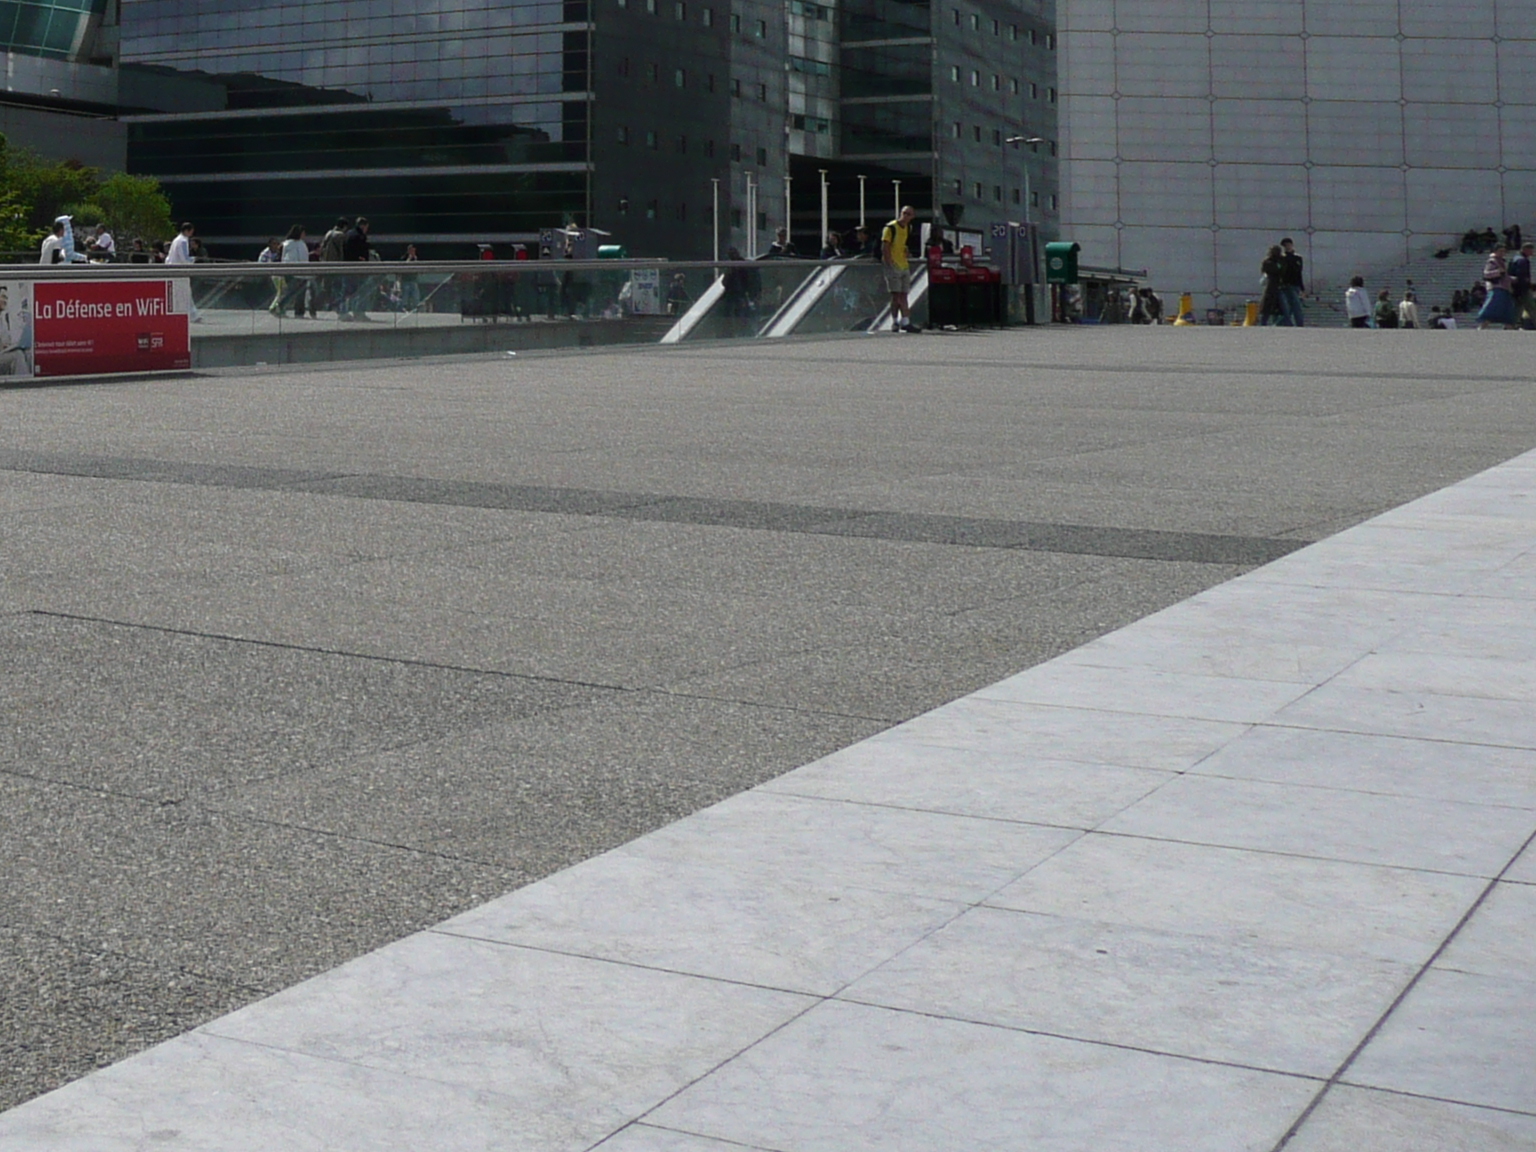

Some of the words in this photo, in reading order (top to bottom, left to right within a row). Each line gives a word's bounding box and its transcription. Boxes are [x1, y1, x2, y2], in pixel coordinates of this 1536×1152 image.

[35, 300, 52, 319] La
[56, 298, 112, 319] Défense
[116, 301, 133, 317] en
[135, 297, 164, 316] WiFi
